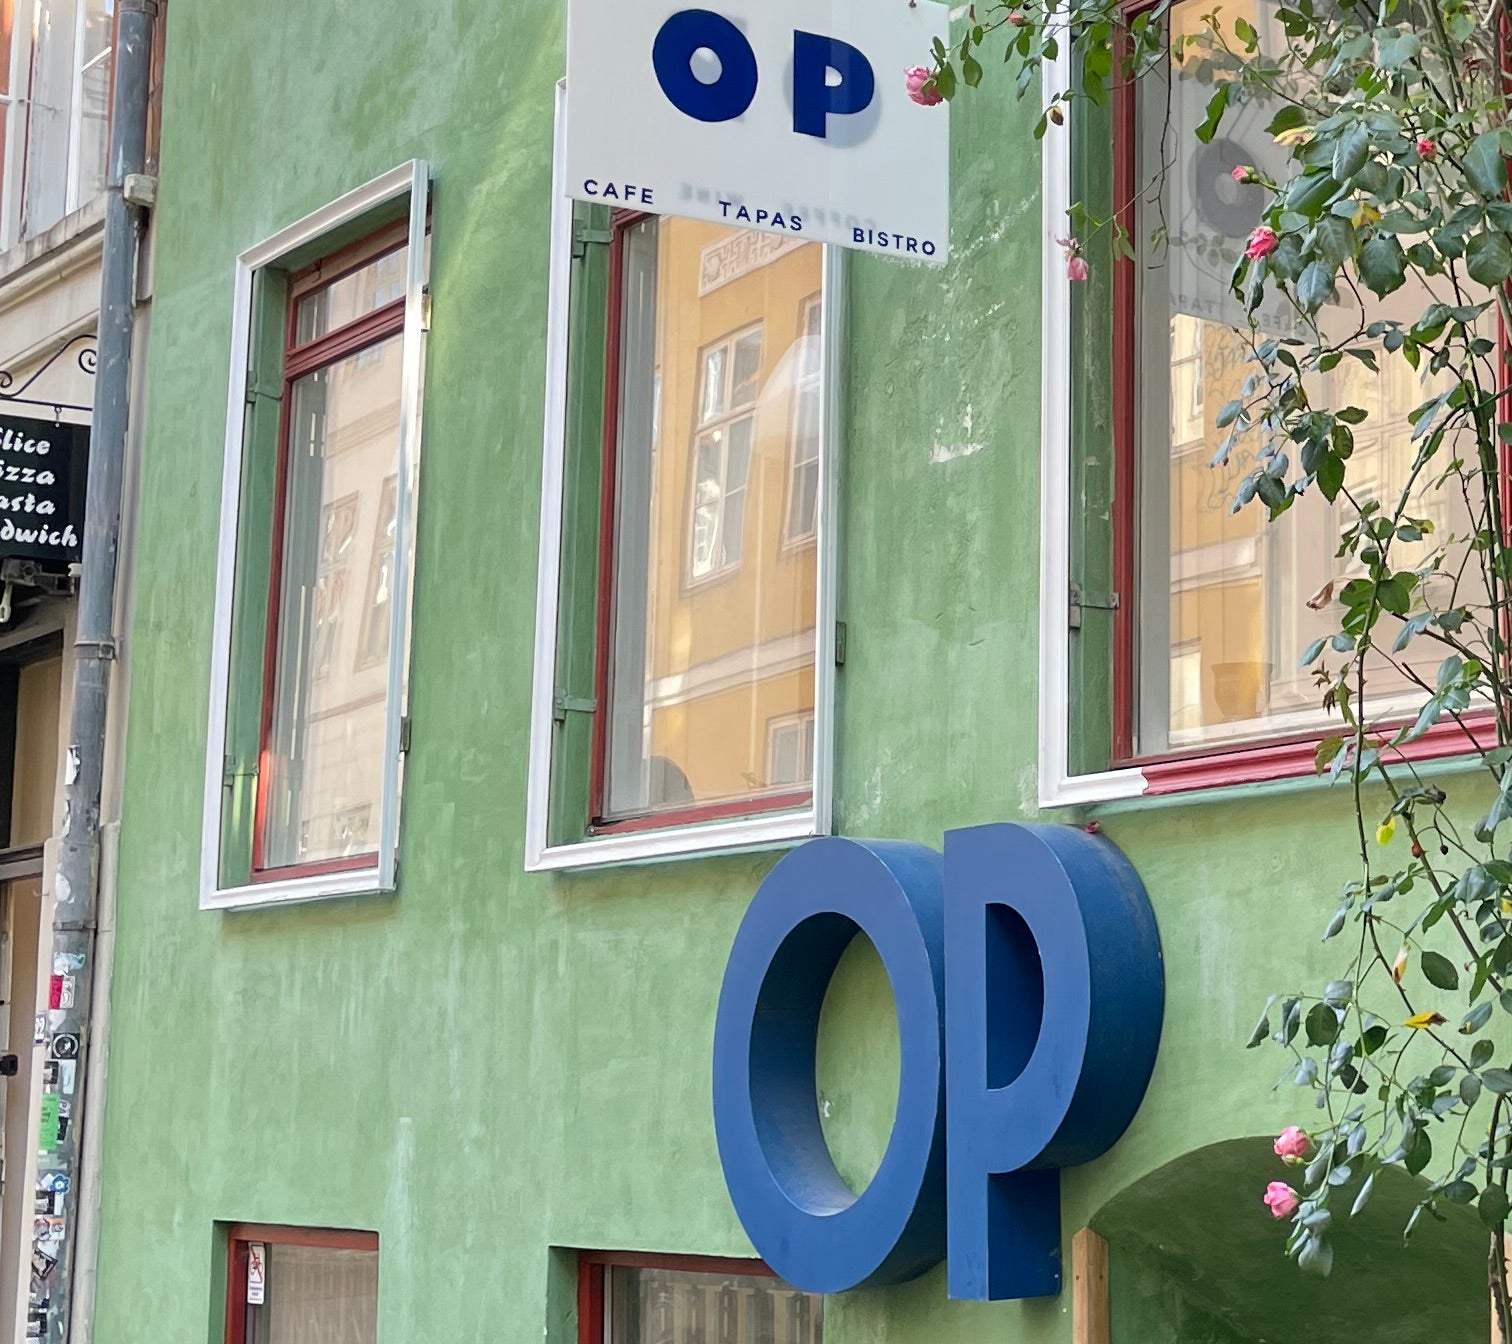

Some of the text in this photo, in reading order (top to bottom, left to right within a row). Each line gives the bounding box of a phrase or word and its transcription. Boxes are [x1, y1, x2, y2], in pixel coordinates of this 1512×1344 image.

[652, 8, 875, 139] OP
[583, 179, 937, 257] CAFE TAPAS BISTRO
[0, 426, 51, 455] lice
[712, 822, 1165, 1300] OP
